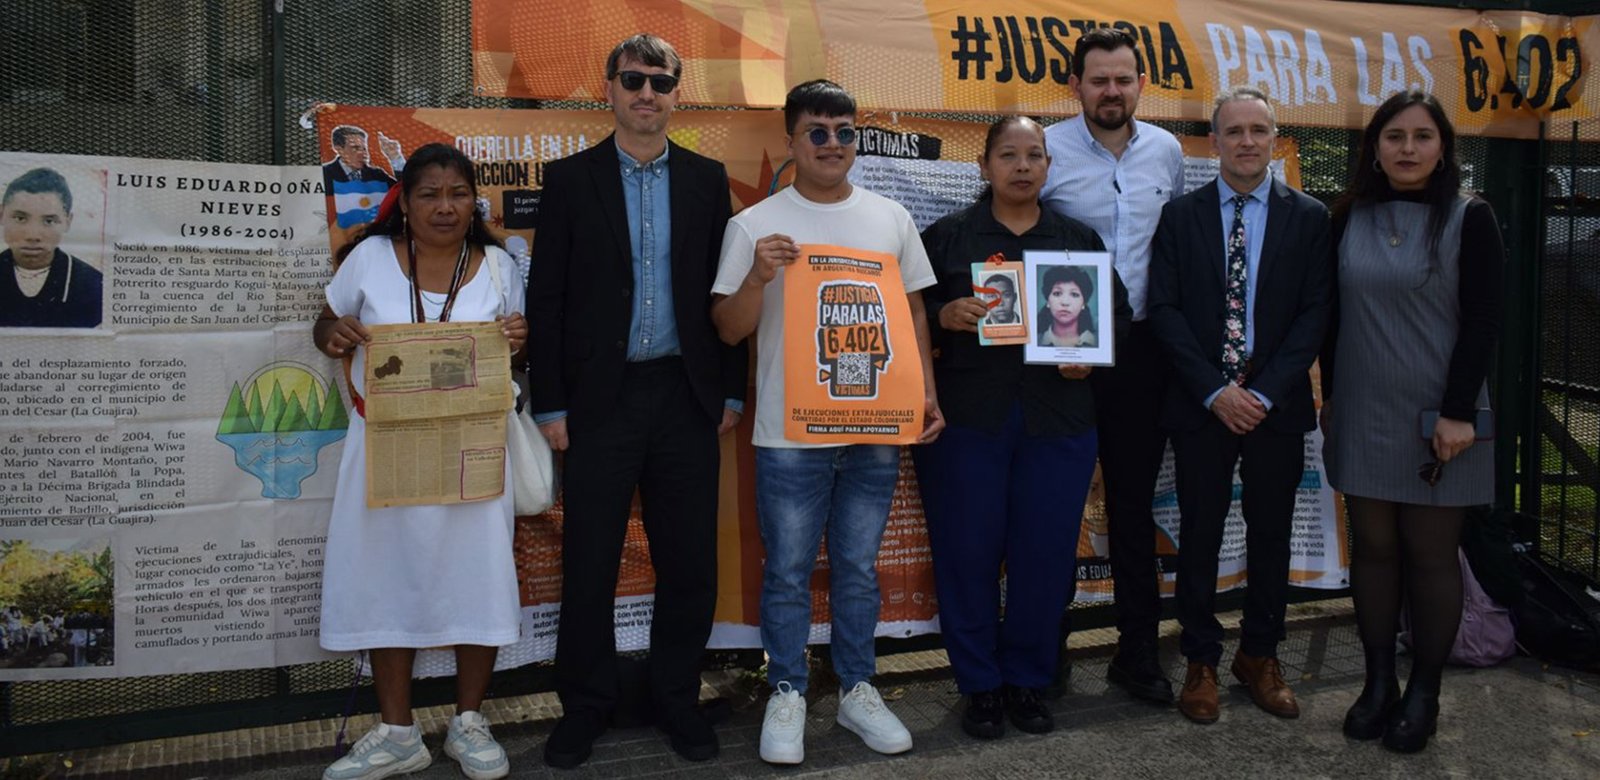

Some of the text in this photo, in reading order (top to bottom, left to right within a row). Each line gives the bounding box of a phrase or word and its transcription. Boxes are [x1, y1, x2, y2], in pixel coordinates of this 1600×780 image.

[951, 16, 1193, 90] #JUSIA
[1205, 23, 1337, 105] PARA
[1351, 32, 1433, 105] LAS
[455, 134, 586, 161] QUERELLA EN LA
[117, 173, 167, 189] LUIS
[177, 177, 282, 194] EDUARDO
[201, 201, 281, 216] NIEVES
[181, 223, 294, 240] (1986-2004)
[255, 248, 273, 256] del
[190, 255, 206, 264] las
[212, 257, 287, 267] estribaciones
[311, 258, 320, 267] la
[113, 266, 156, 276] Nevada
[160, 267, 174, 276] de
[178, 267, 210, 276] Santa
[215, 268, 247, 277] Marta
[269, 270, 278, 278] la
[113, 279, 229, 290] Potrerito resguardo
[112, 291, 295, 300] en la cuenca del San
[823, 286, 879, 303] #JUSTICIA
[112, 302, 246, 314] Corregimiento de la
[112, 314, 259, 326] Municipio de San Juan del
[827, 326, 880, 353] 6.402
[12, 358, 30, 368] del
[39, 358, 131, 370] desplazamiento
[14, 370, 77, 380] abandonar
[98, 370, 128, 382] lugar
[131, 370, 146, 380] de
[150, 371, 186, 381] origen
[55, 381, 186, 394] al corregimiento de
[17, 393, 186, 405] ubicado en el municipio de
[12, 407, 30, 416] del
[34, 406, 67, 416] Cesar
[71, 406, 88, 418] (La
[803, 408, 849, 416] EJECUCIONES
[9, 433, 24, 443] de
[38, 433, 81, 443] febrero
[94, 433, 109, 443] de
[167, 430, 186, 440] fue
[22, 443, 185, 458] junto con el Wiwa
[4, 458, 39, 467] Mario
[47, 458, 94, 467] Navarro
[165, 455, 186, 465] por
[38, 469, 57, 479] del
[130, 467, 140, 477] la
[23, 478, 185, 492] la Décima Brigada Blindada
[139, 492, 154, 500] en
[175, 489, 185, 498] el
[48, 506, 62, 515] de
[30, 517, 48, 527] del
[51, 517, 85, 526] Cesar
[87, 515, 105, 527] (La
[203, 539, 256, 551] de las
[135, 555, 202, 569] ejecuciones
[307, 548, 321, 556] en
[135, 564, 254, 580] lugar conocido como
[135, 571, 321, 591] armados les ordenaron bajarse
[189, 587, 246, 599] en el que
[135, 604, 169, 615] Horas
[227, 598, 243, 607] los
[247, 597, 266, 606] dos
[135, 608, 270, 626] la comunidad Wiwa
[135, 620, 265, 637] muertos vistiendo
[134, 630, 297, 648] camuflados portando armas
